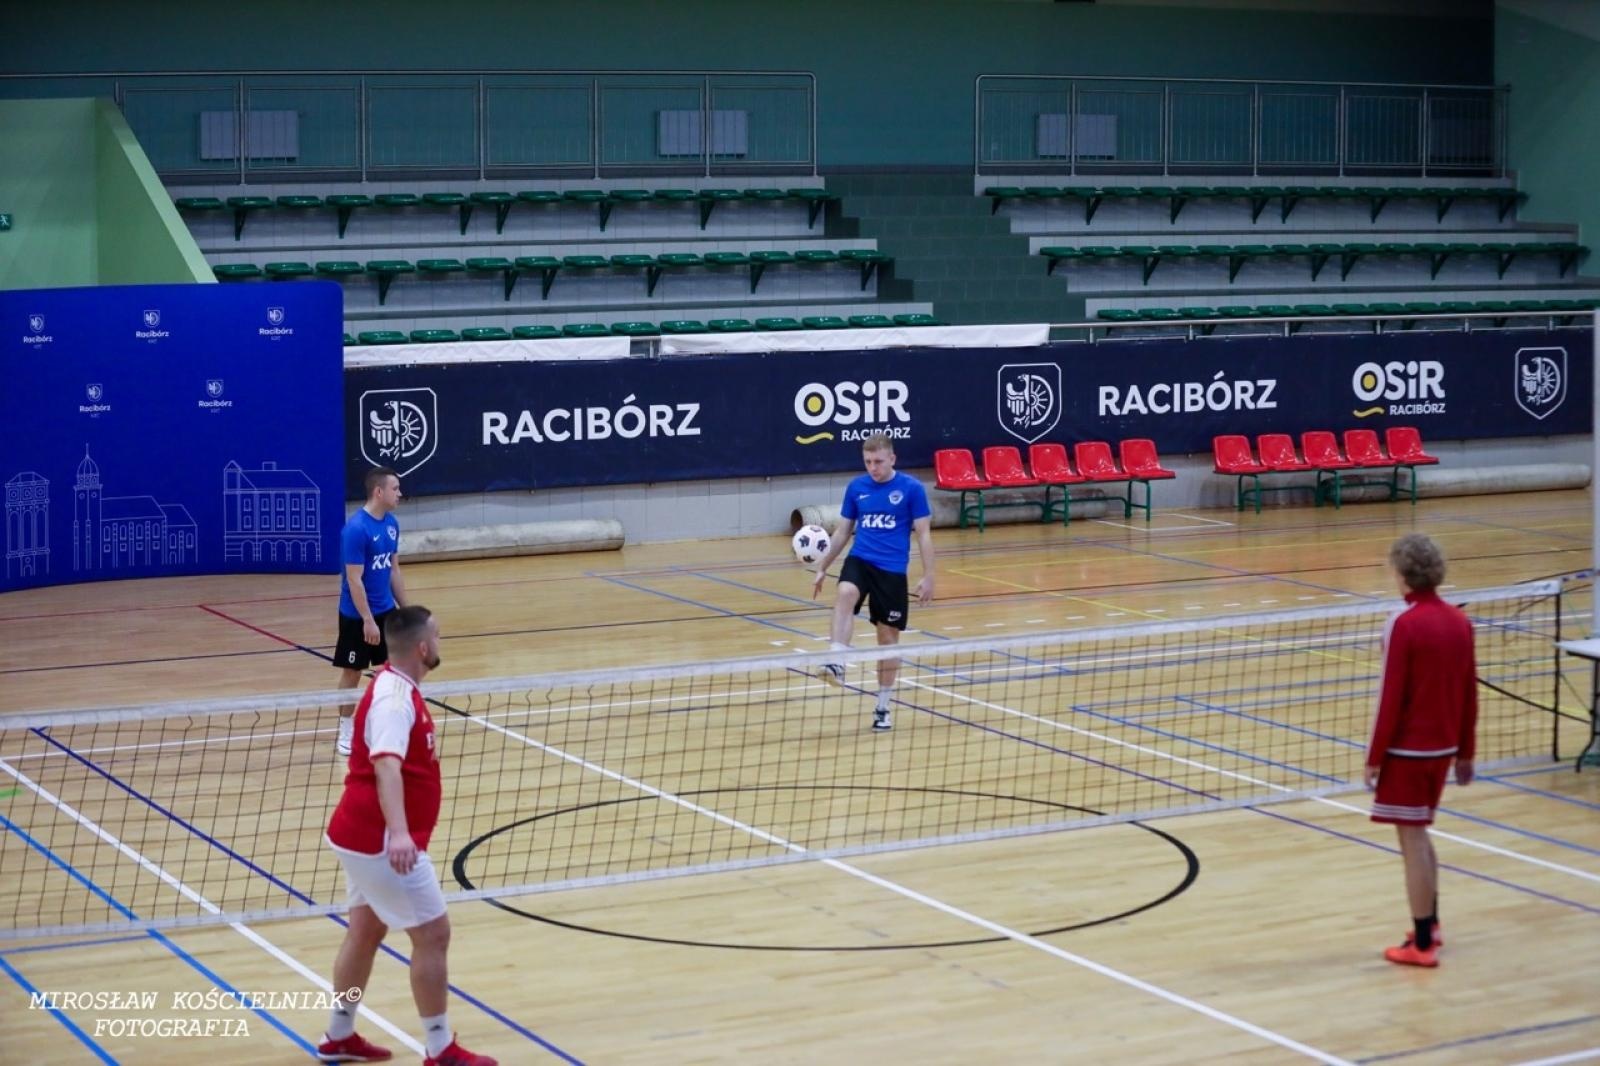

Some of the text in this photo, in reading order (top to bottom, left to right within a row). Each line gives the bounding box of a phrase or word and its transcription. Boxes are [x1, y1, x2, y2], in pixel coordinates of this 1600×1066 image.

[1098, 370, 1277, 416] RACIBÓRZ
[482, 394, 701, 445] RACIBÓRZ
[1390, 402, 1446, 416] RACIBÓRZ
[348, 650, 356, 664] 6
